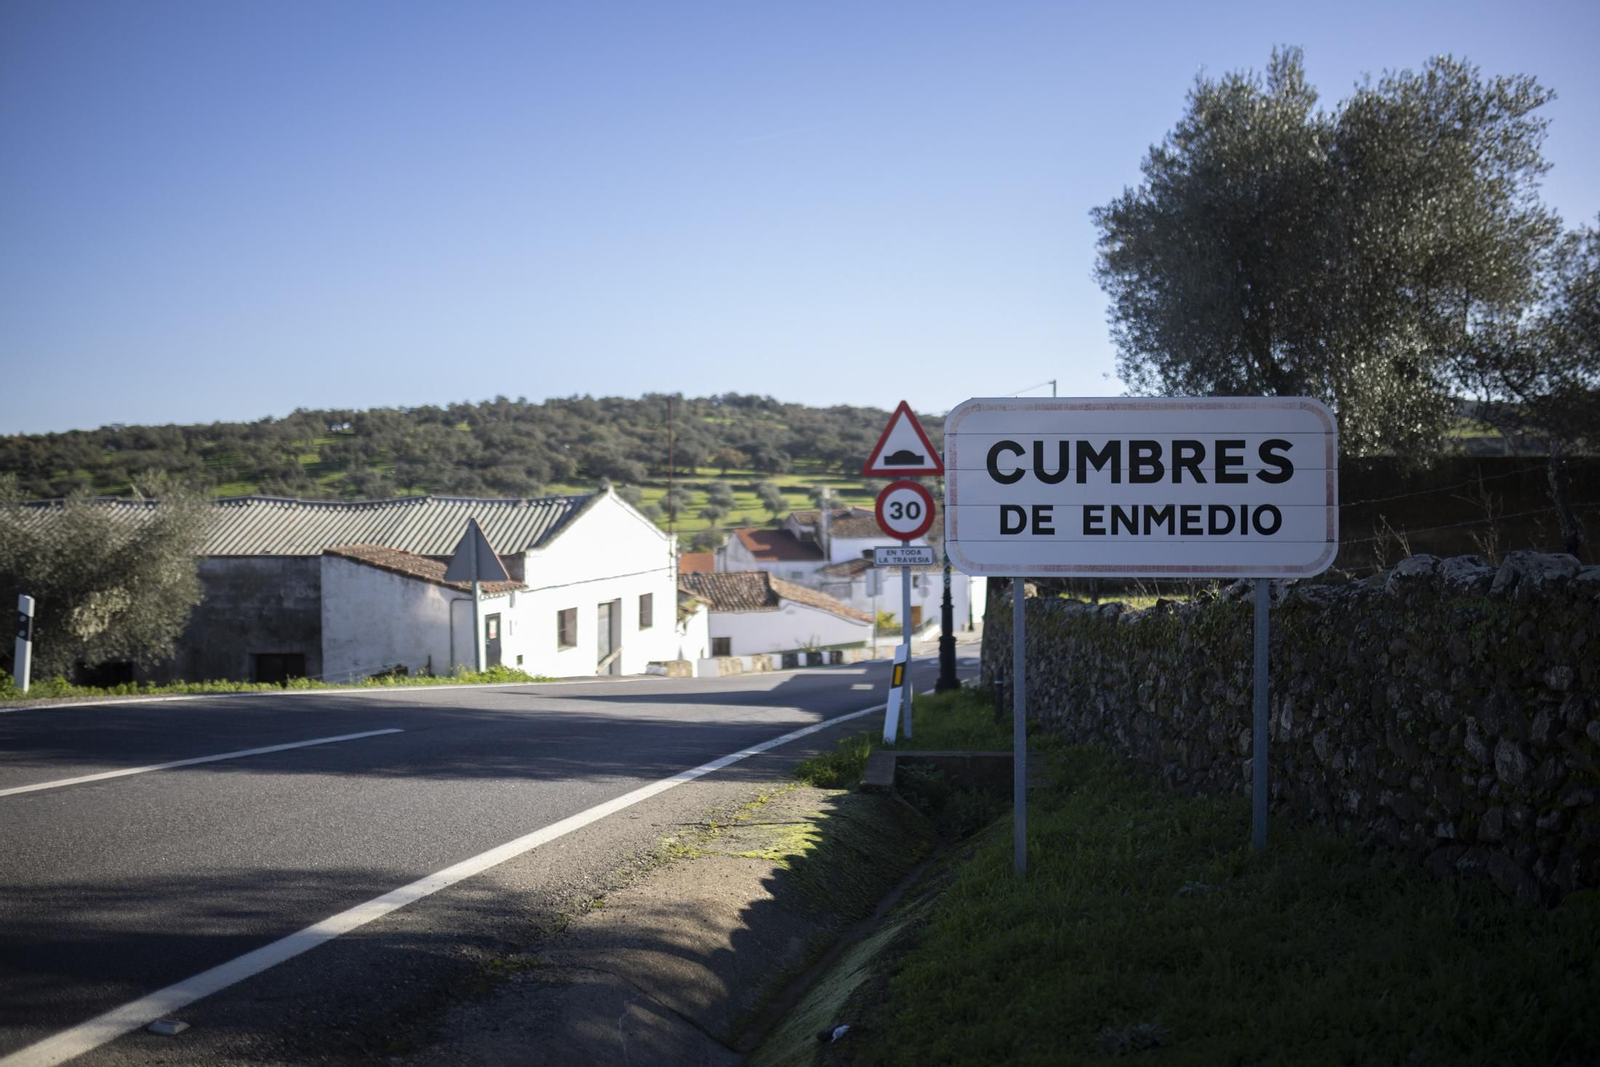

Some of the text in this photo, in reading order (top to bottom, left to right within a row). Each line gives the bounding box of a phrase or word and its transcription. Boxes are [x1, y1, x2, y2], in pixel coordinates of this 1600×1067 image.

[986, 439, 1294, 484] CUMBRES
[890, 501, 921, 520] 30
[1000, 504, 1282, 536] DE ENMEDIO
